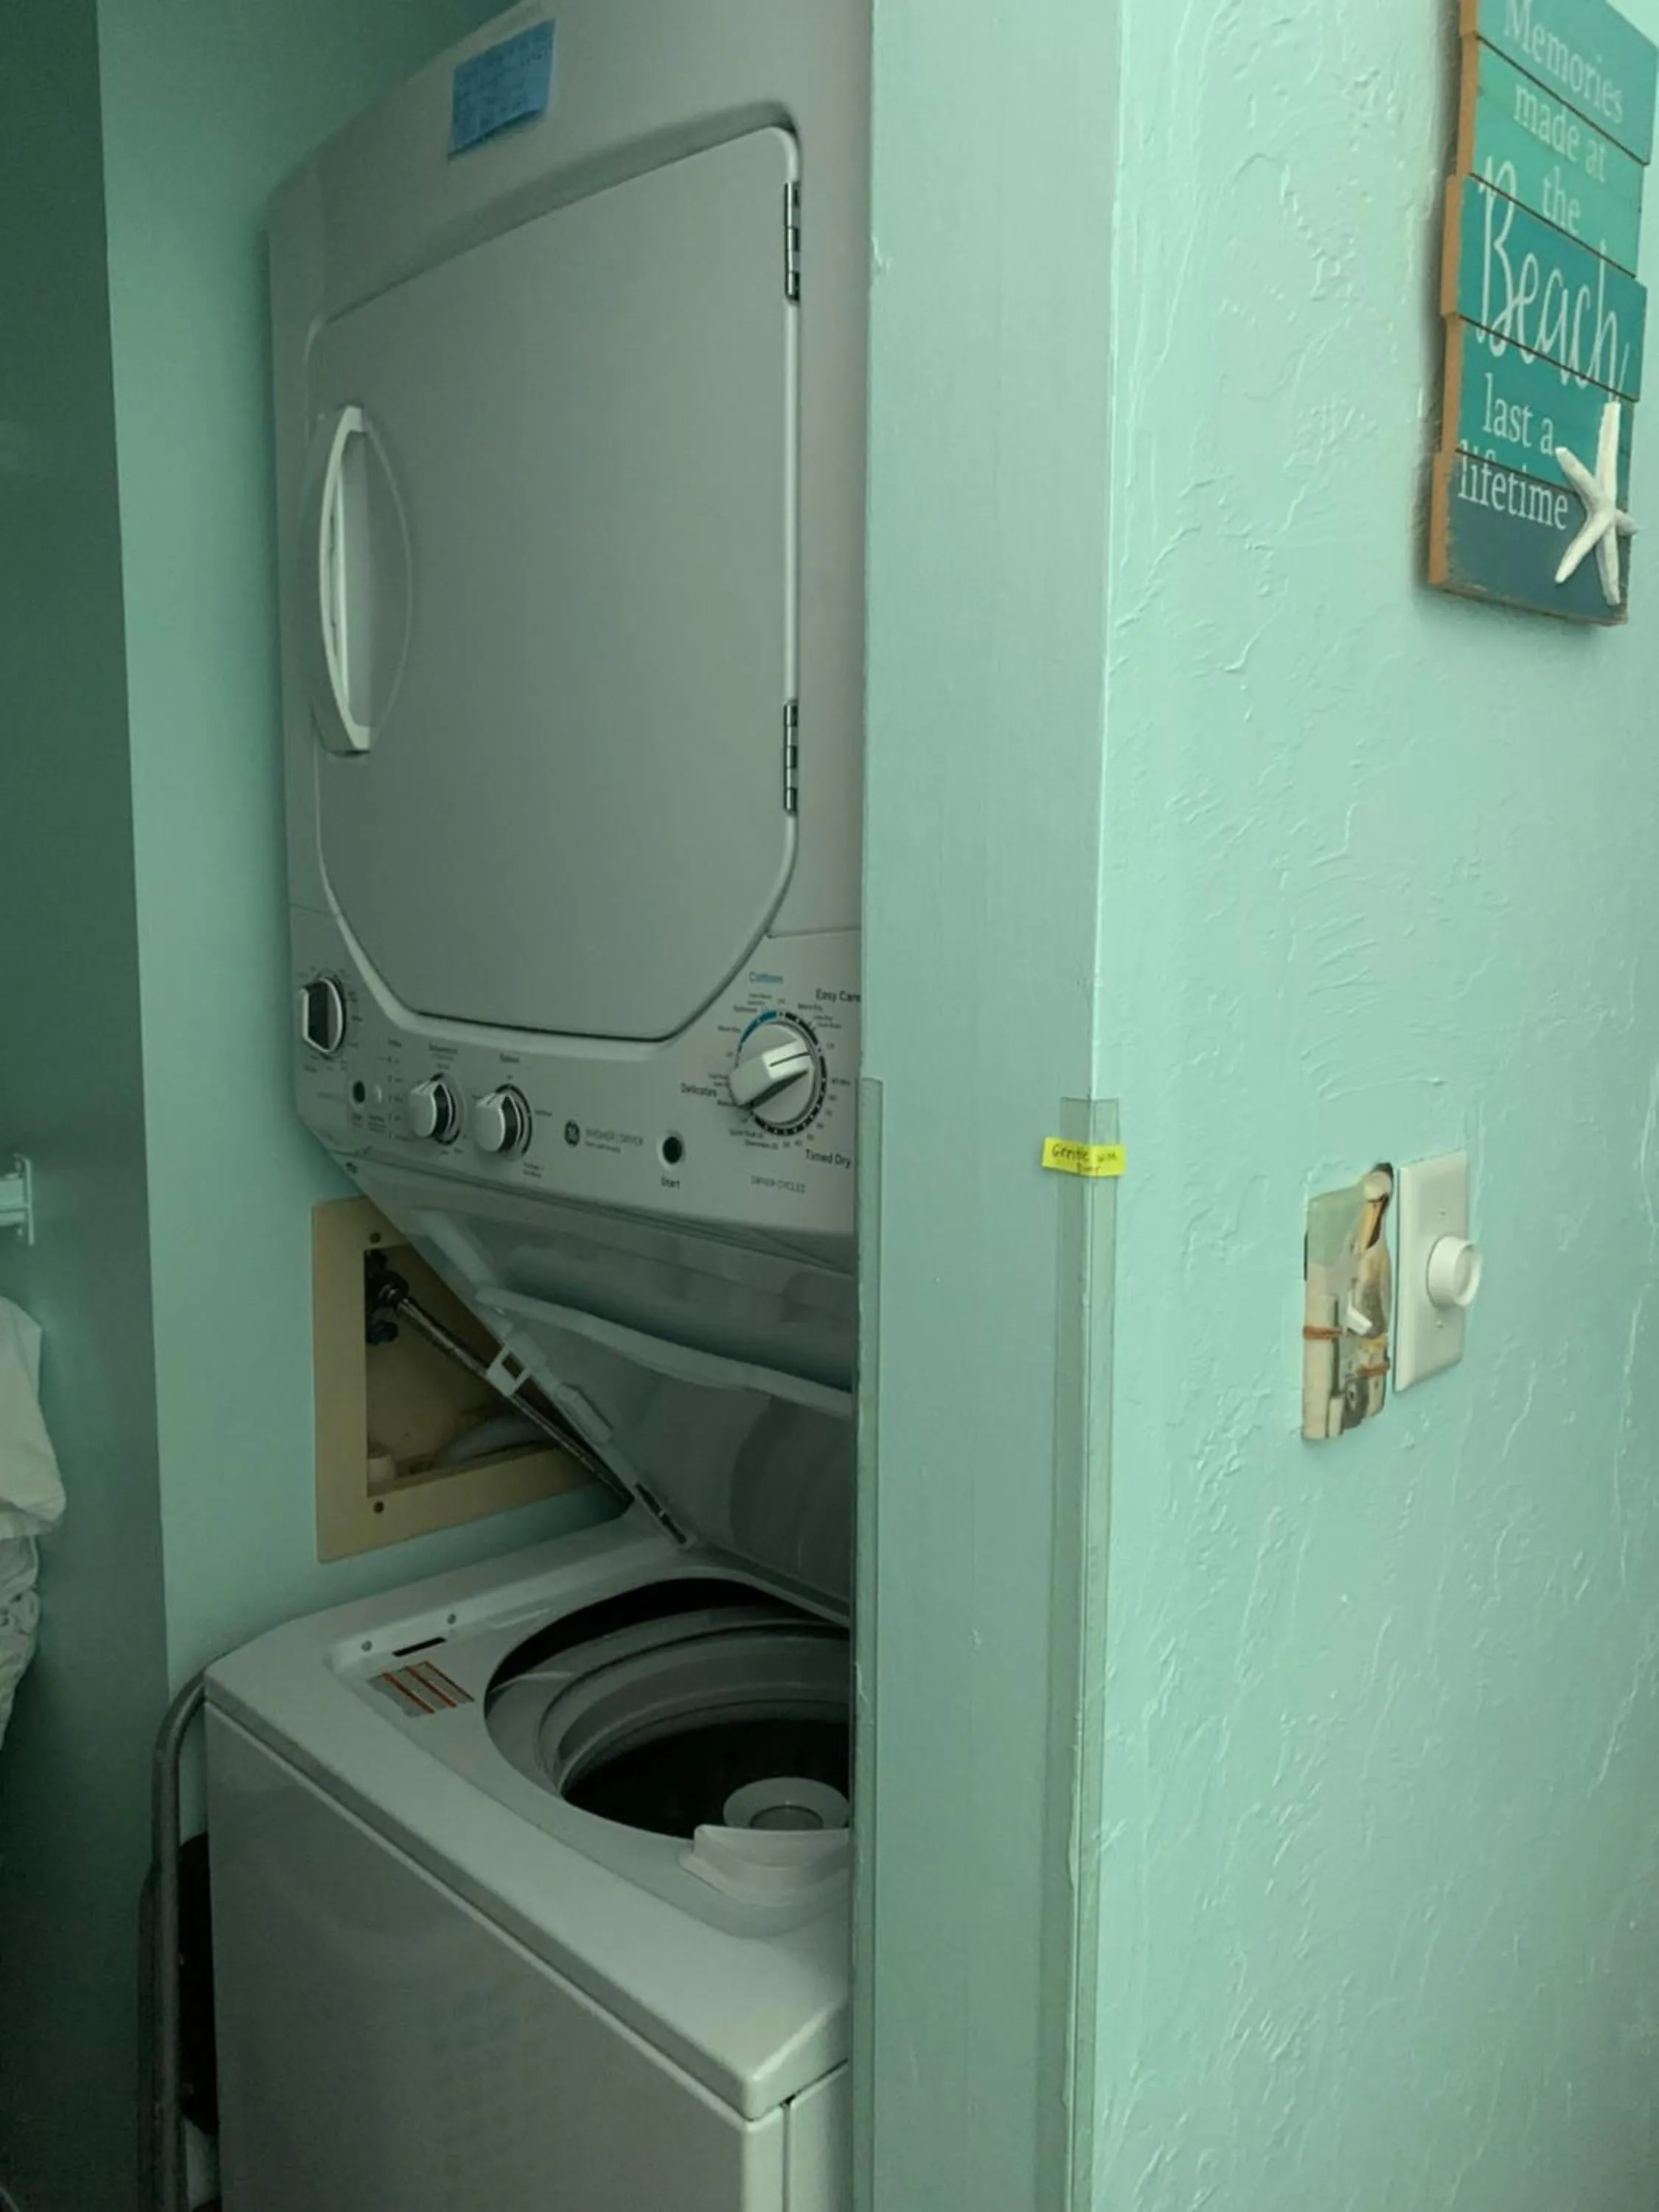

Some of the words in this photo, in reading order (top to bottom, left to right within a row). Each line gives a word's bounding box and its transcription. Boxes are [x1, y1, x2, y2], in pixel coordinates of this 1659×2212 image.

[1504, 0, 1623, 124] Memories
[1514, 85, 1581, 163] made
[1585, 139, 1607, 183] at
[1543, 165, 1581, 235] the
[1476, 156, 1630, 405] Beach
[1482, 372, 1533, 448] last
[1540, 417, 1554, 457] a
[1458, 439, 1569, 530] lifetime
[815, 988, 837, 1004] Easy
[806, 1149, 833, 1164] Timed
[835, 1153, 852, 1169] Dry
